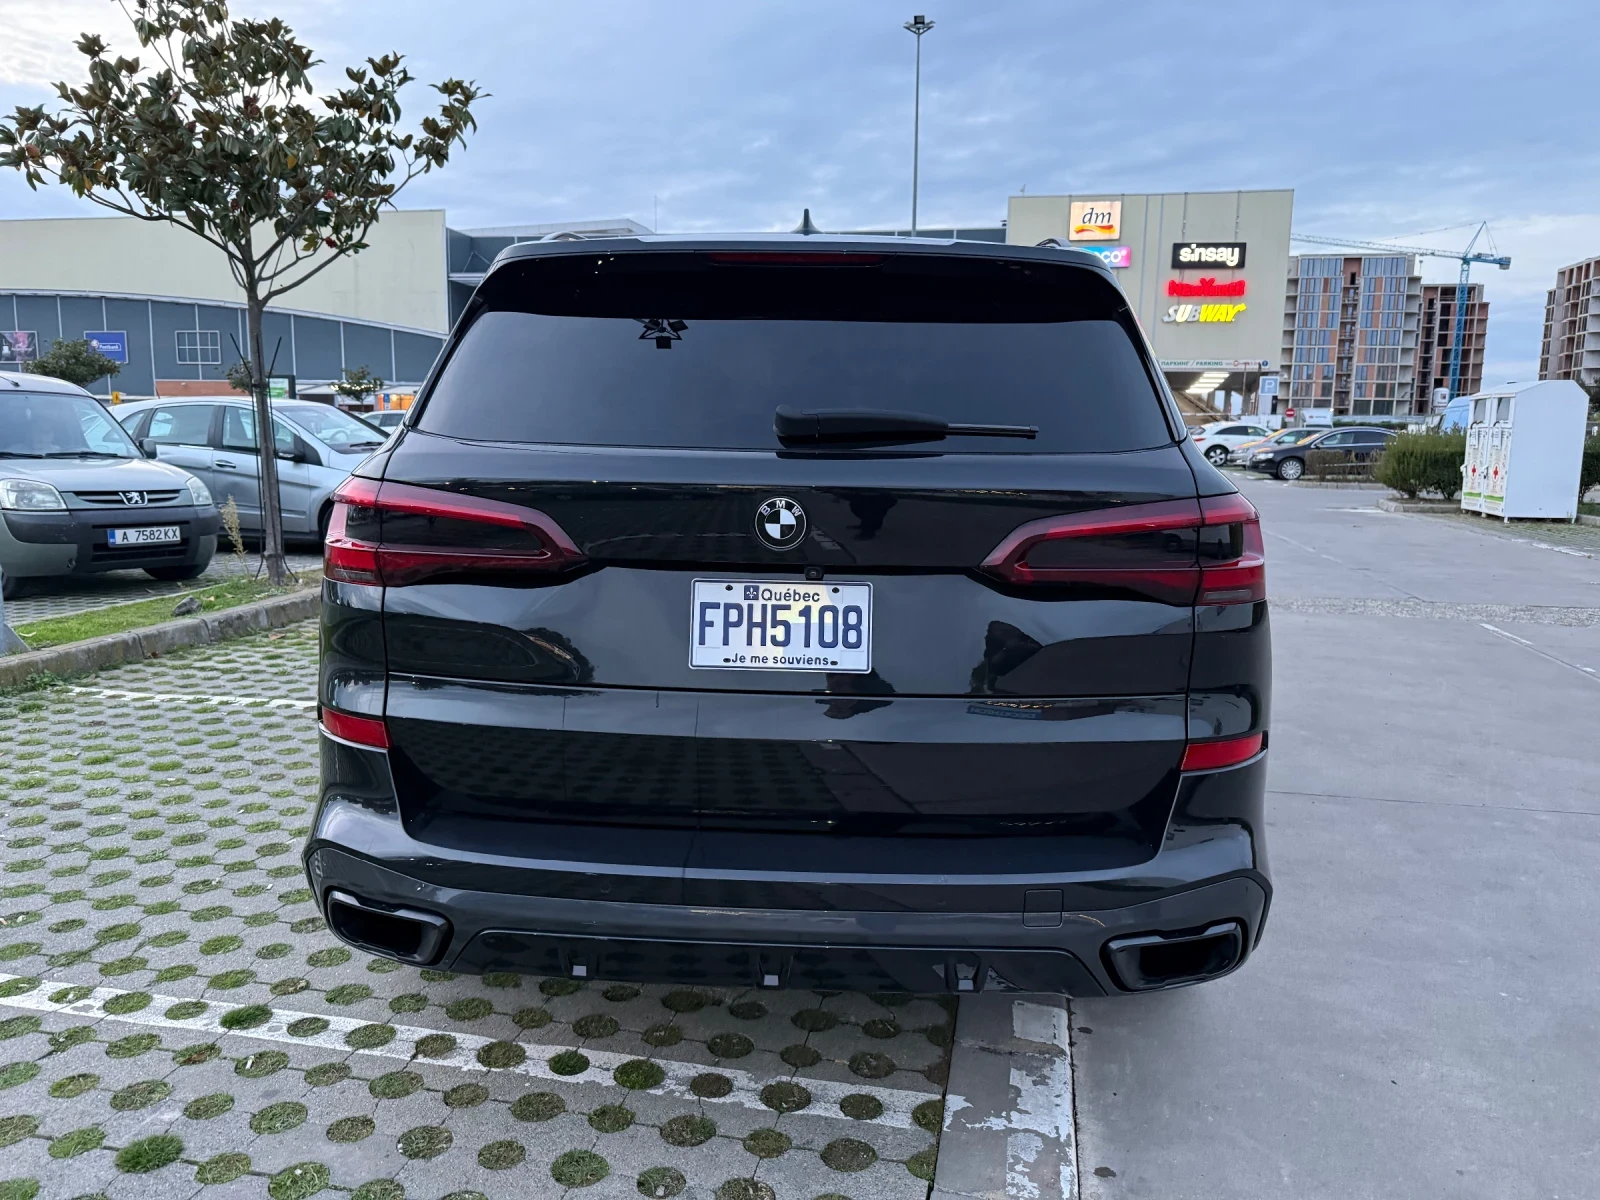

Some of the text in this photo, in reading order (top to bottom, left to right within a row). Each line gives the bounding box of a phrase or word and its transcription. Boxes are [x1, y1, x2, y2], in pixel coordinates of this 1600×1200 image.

[1082, 207, 1112, 225] dm
[1179, 244, 1240, 267] sinsay
[1162, 303, 1247, 323] SUBWAY
[760, 500, 802, 517] BMW
[122, 531, 129, 543] A
[135, 529, 162, 542] 7582
[164, 528, 178, 539] KX
[761, 588, 821, 602] Québec
[698, 602, 863, 649] FPH5108
[732, 653, 829, 666] Je me souviens
